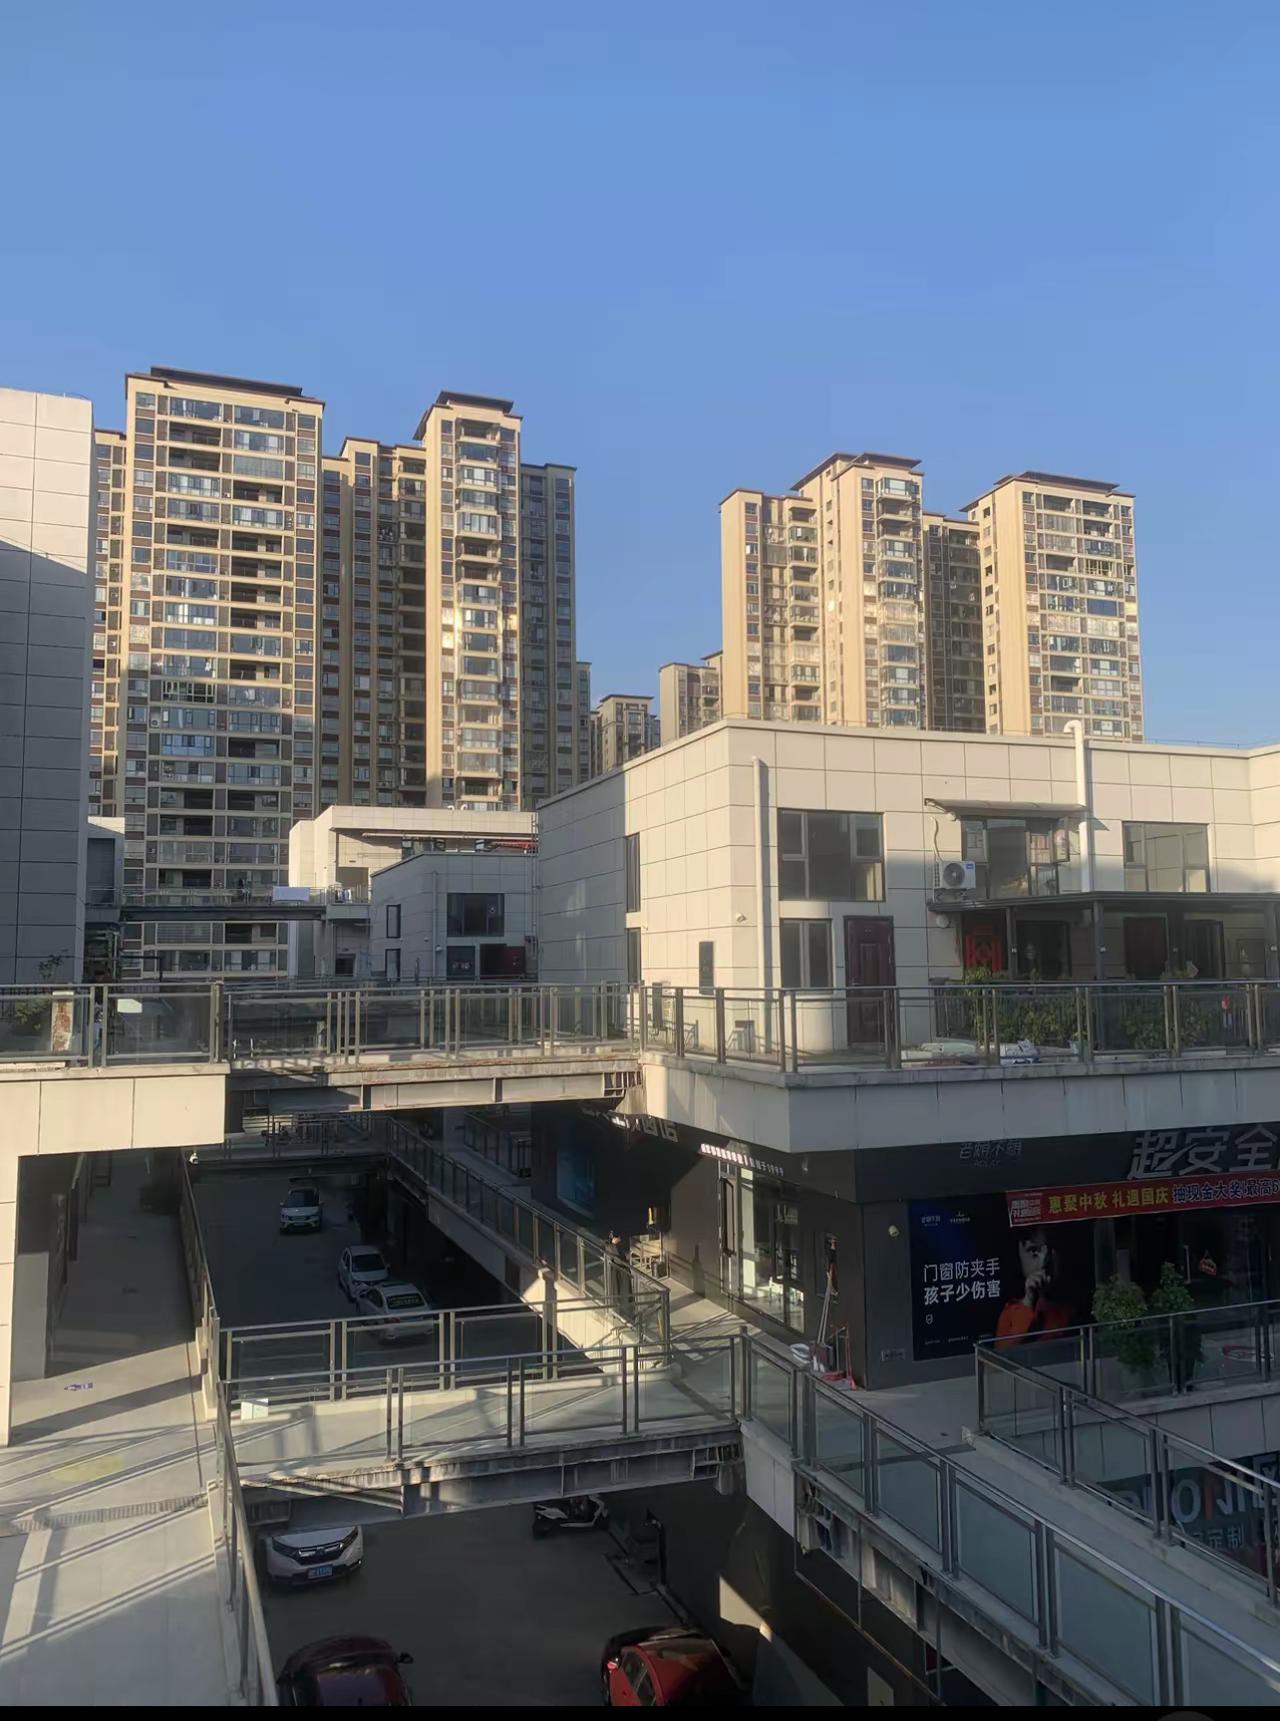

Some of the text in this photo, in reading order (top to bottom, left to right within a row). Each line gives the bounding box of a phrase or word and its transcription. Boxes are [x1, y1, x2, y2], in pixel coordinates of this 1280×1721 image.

[1126, 1124, 1279, 1179] 超安全
[1047, 1191, 1109, 1214] 惠聚中秋
[1112, 1187, 1169, 1208] 礼遇国庆
[923, 1257, 1001, 1283] 门窗防夹手
[923, 1280, 1001, 1306] 孩子少伤害
